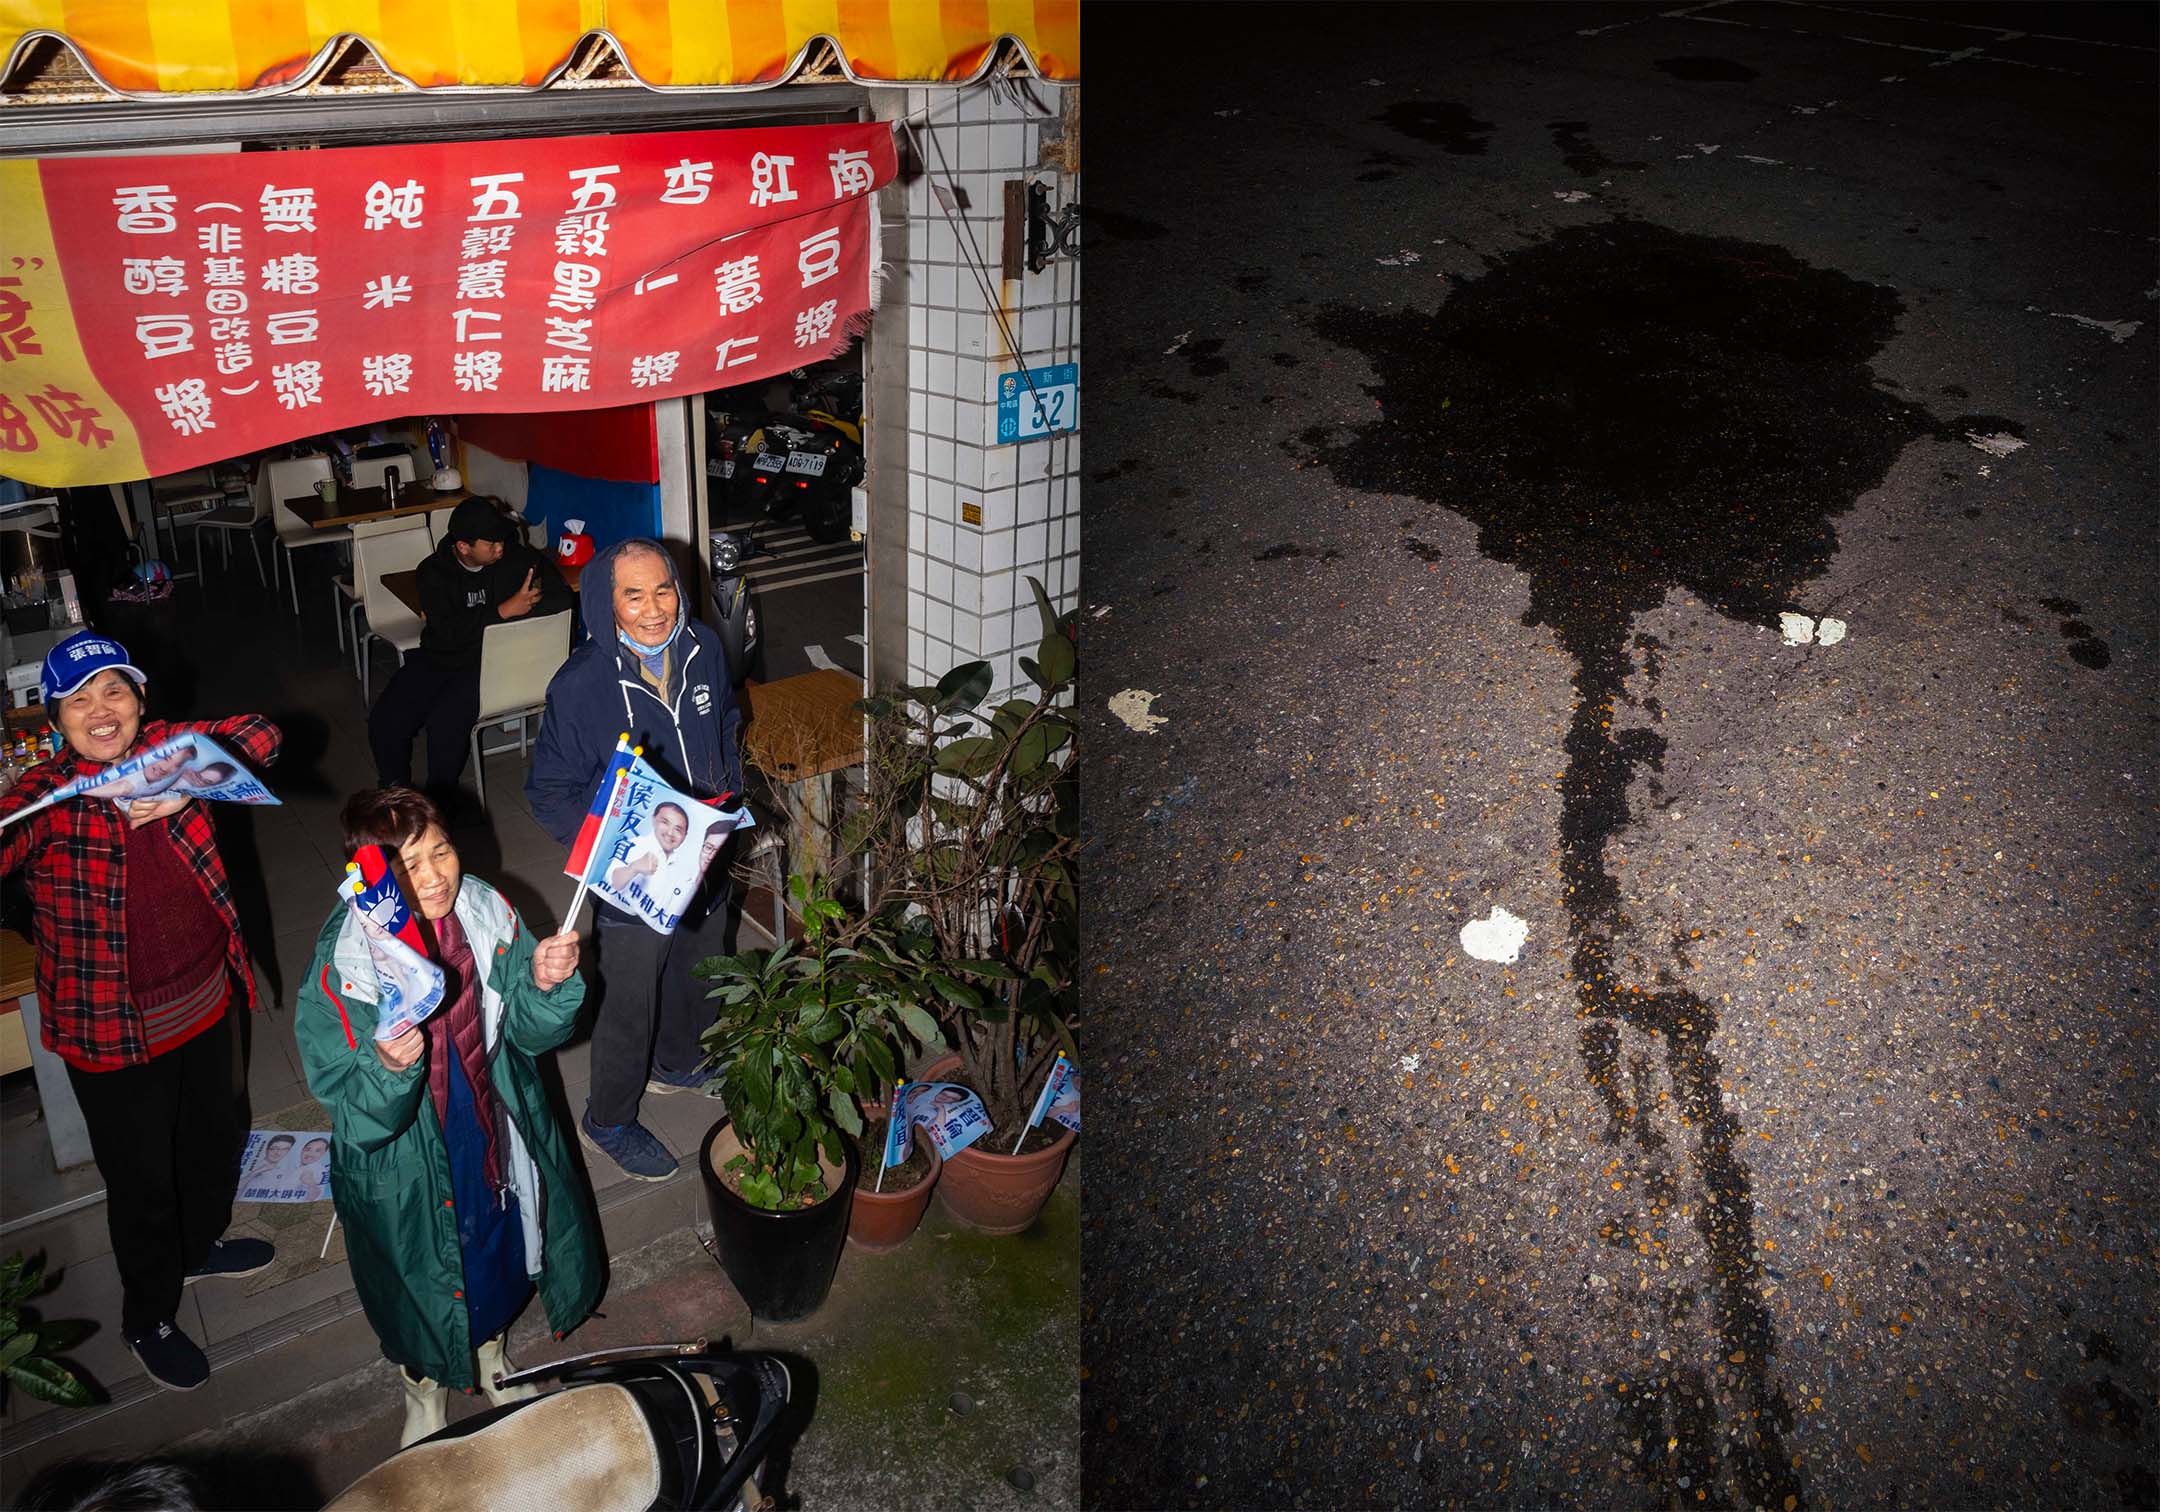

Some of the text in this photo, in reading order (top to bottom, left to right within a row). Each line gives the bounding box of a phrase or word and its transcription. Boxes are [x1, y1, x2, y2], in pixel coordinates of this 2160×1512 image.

[112, 185, 216, 436] 香醇豆漿
[193, 202, 260, 396] （非基因改造）
[259, 184, 323, 410] 無糖豆漿
[362, 180, 425, 396] 純米漿
[452, 172, 524, 392] 五穀薏仁漿
[542, 165, 621, 392] 五穀黑芝麻
[715, 151, 798, 371] 紅薏仁
[1032, 390, 1065, 430] 52
[607, 781, 655, 866] 侯友宜
